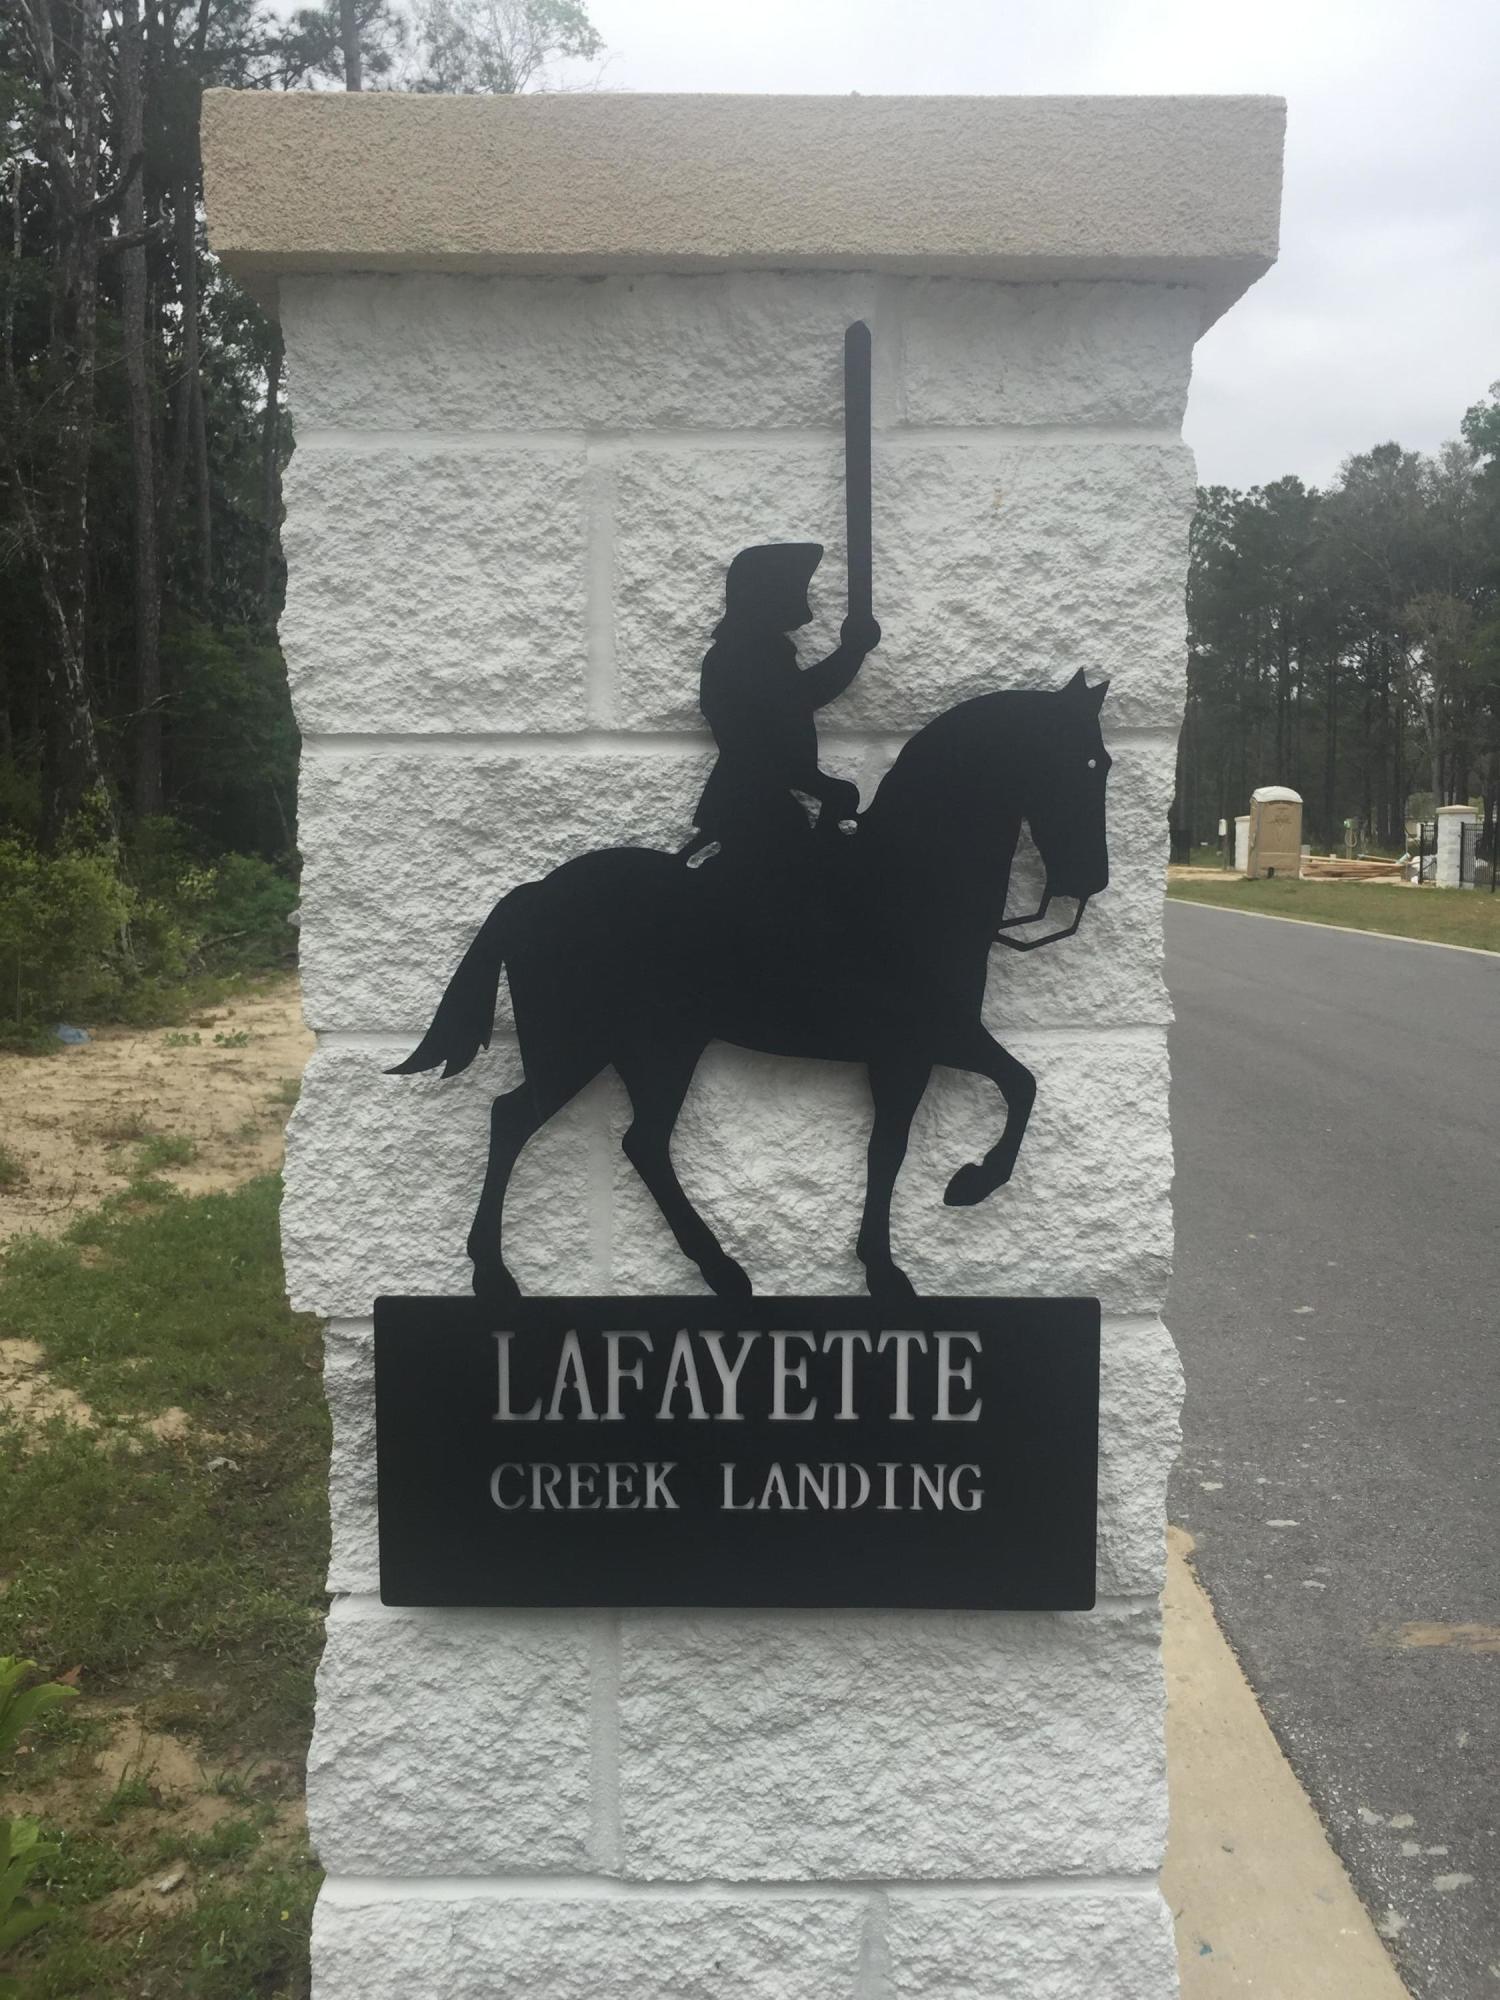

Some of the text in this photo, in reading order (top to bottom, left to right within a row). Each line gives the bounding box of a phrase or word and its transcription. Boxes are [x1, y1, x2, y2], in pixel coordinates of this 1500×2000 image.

[491, 1329, 983, 1421] LAFAYETTE
[490, 1462, 985, 1511] CREEK LANDING
